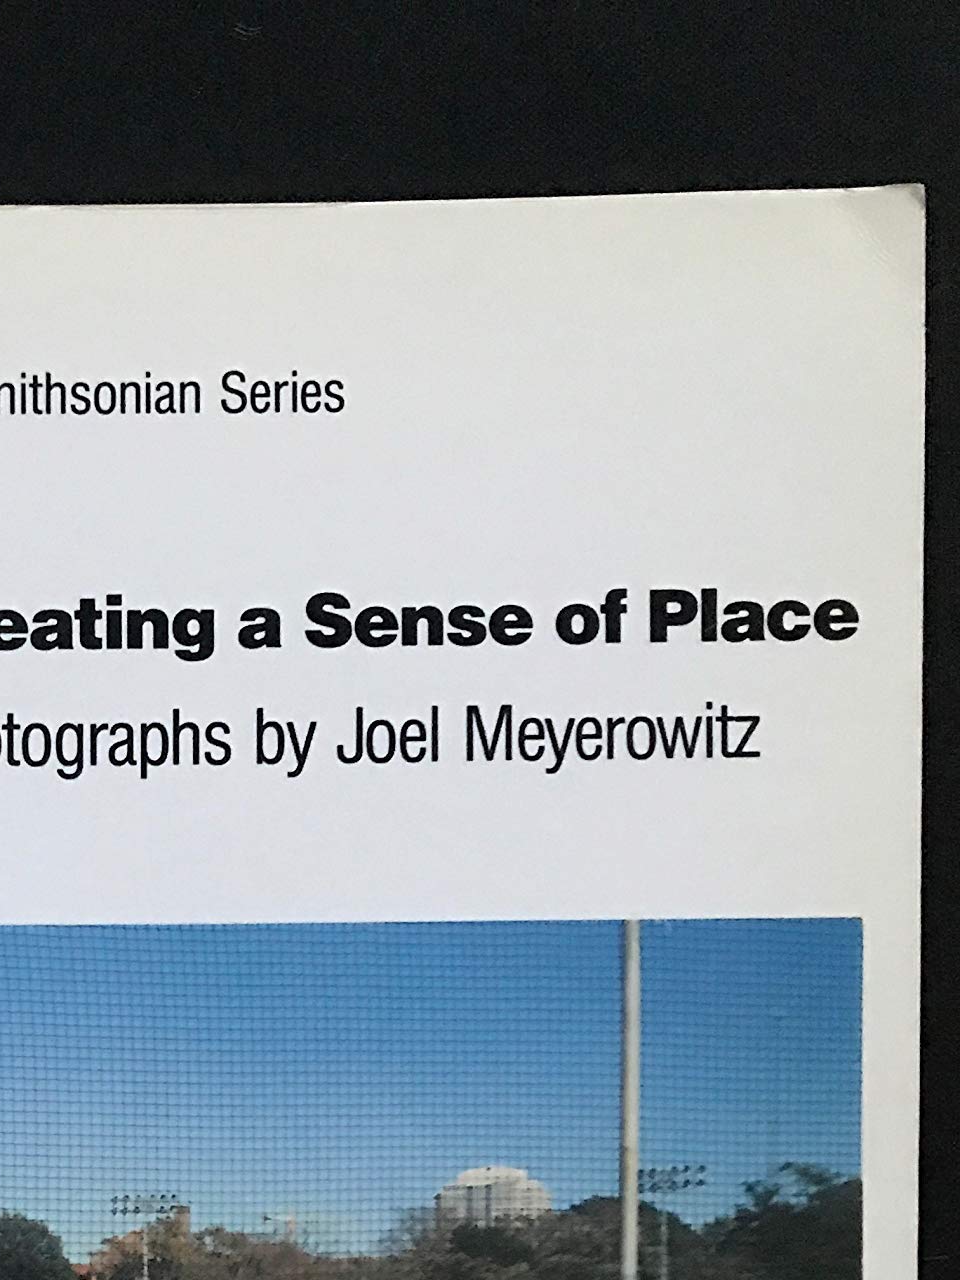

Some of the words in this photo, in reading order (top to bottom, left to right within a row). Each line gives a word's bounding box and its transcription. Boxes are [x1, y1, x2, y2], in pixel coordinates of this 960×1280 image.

[220, 370, 345, 415] Series
[237, 607, 282, 650] a
[304, 592, 534, 649] Sense
[555, 588, 628, 646] of
[649, 587, 860, 643] Place
[256, 707, 317, 778] by
[336, 705, 439, 764] Joel
[466, 701, 761, 775] Meyerowitz
